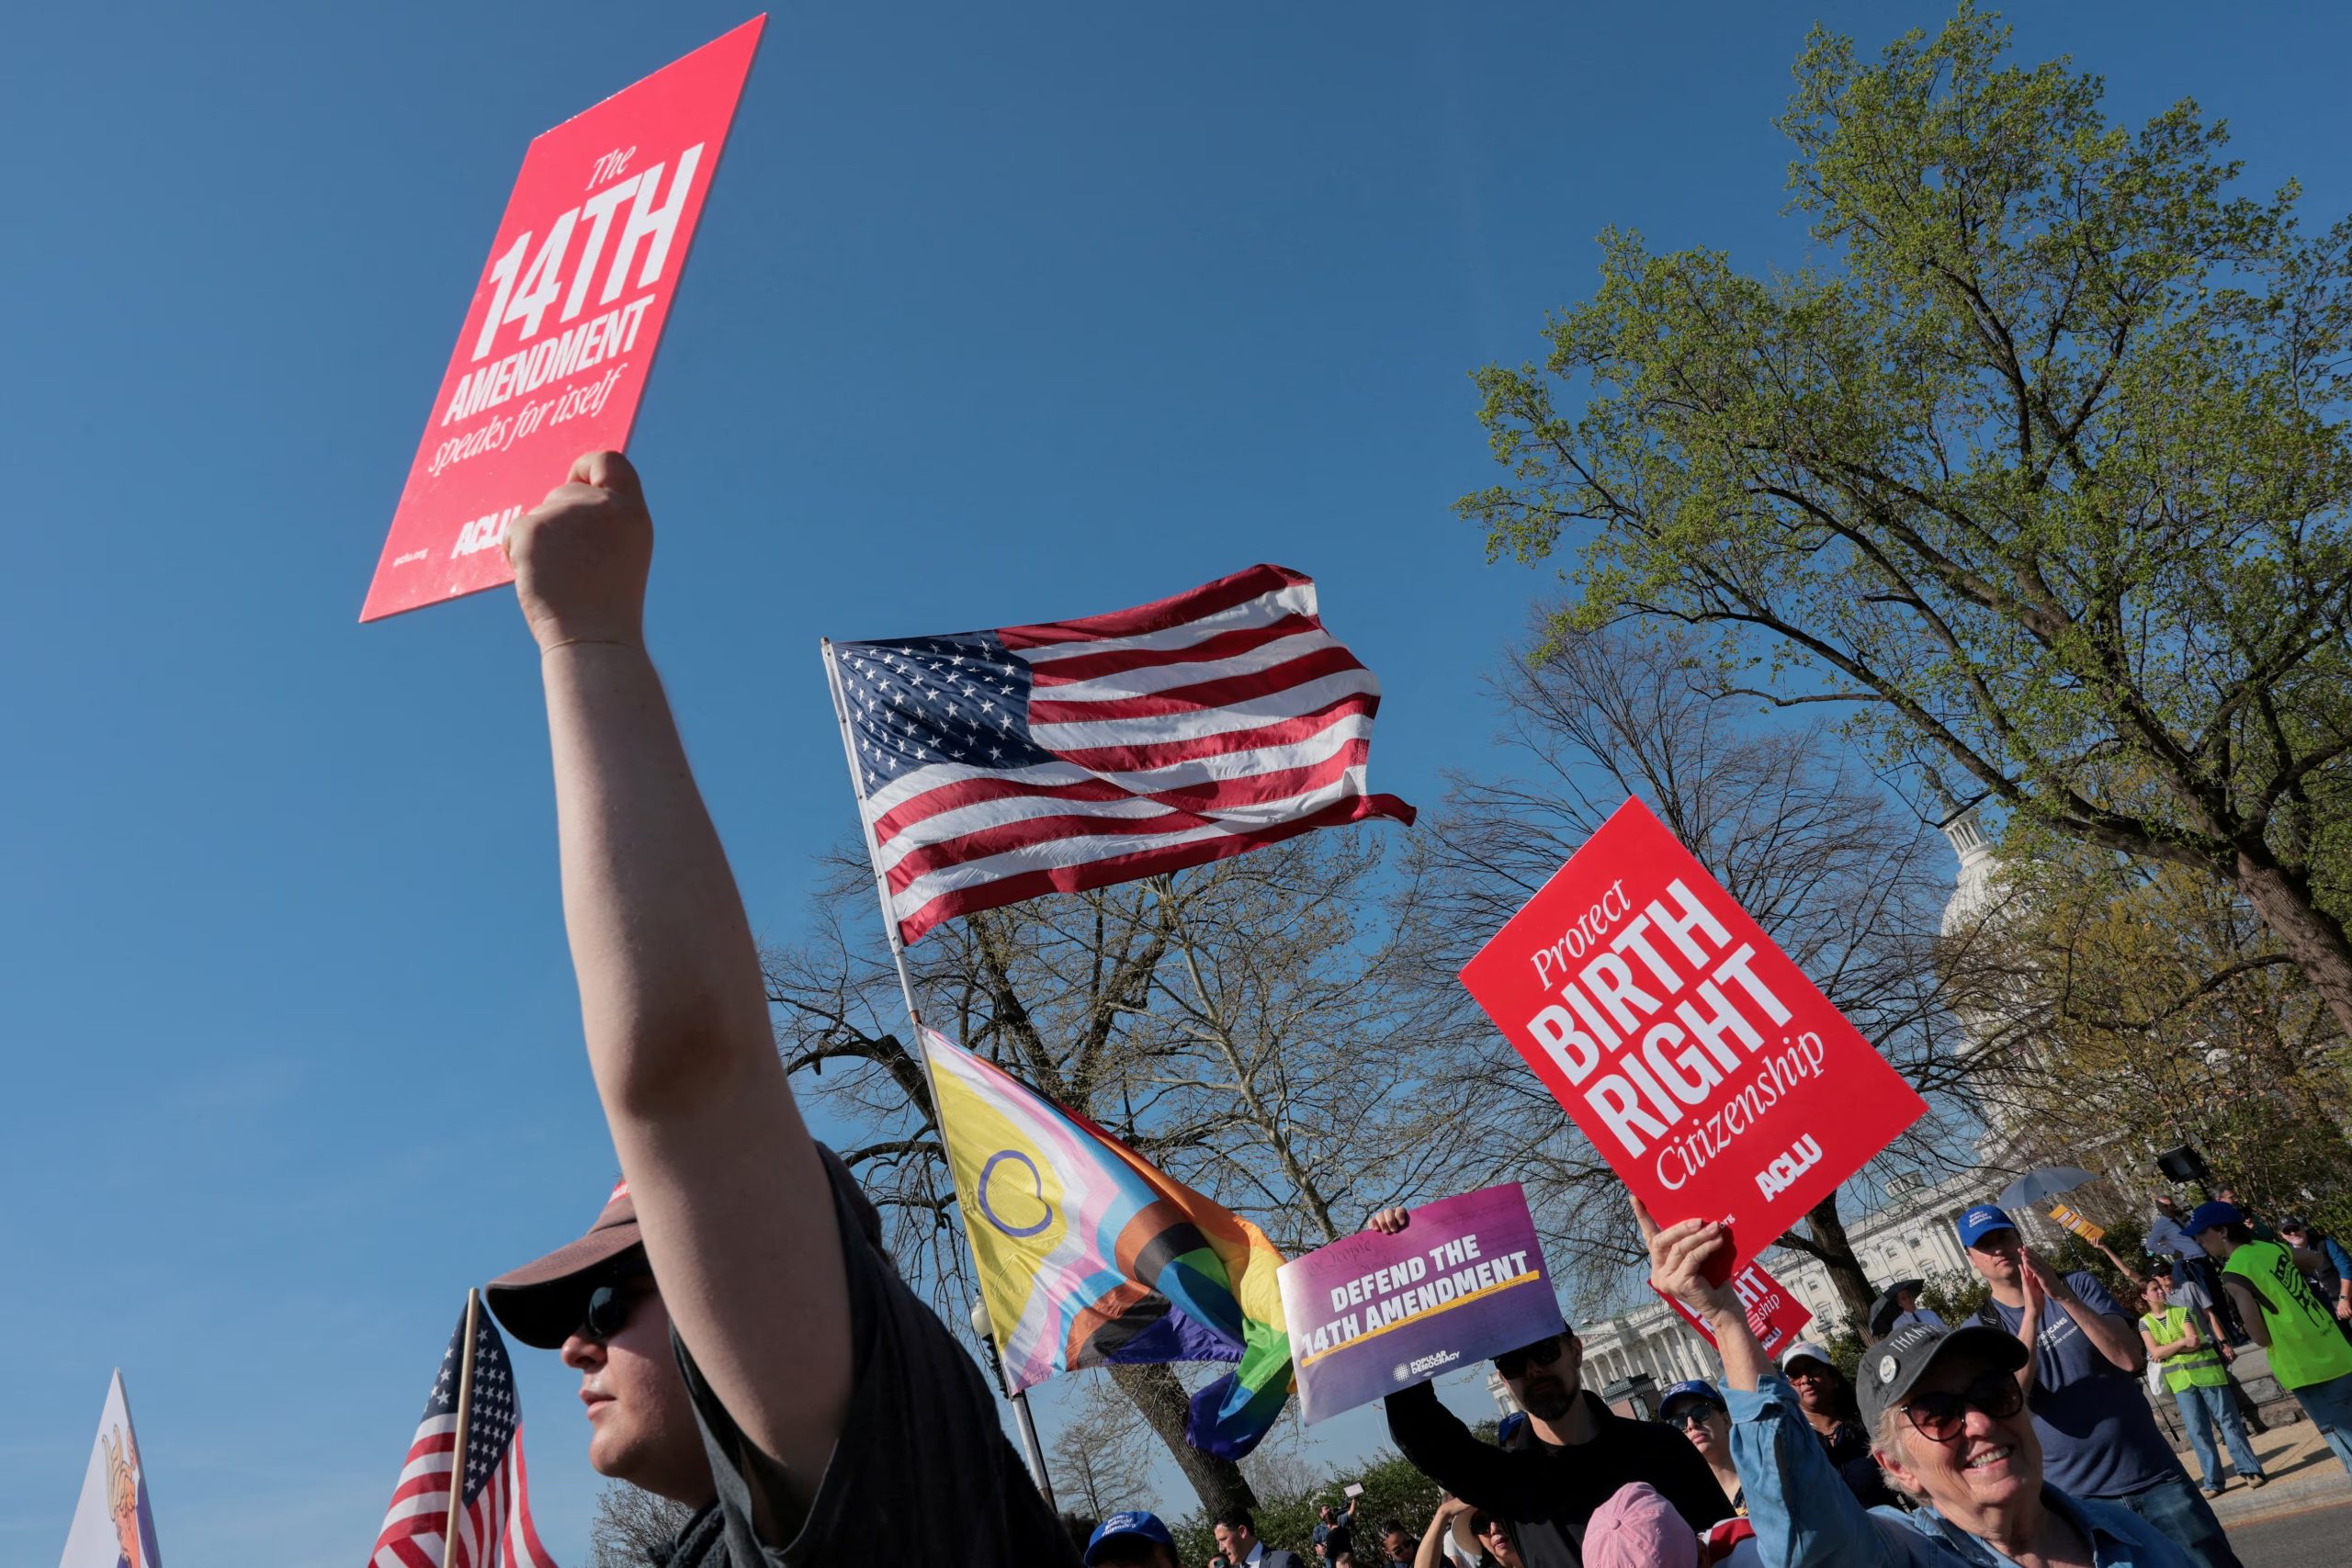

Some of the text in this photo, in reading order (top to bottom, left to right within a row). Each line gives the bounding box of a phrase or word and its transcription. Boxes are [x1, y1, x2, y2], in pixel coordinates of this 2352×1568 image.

[584, 145, 637, 191] The
[470, 141, 706, 363] 14TH
[441, 293, 656, 427] AMENDMENT
[428, 362, 629, 478] speaks for itself
[1526, 877, 1733, 1087] BIRTH
[1530, 878, 1631, 991] Protect
[1583, 942, 1793, 1159] RIGHT
[1656, 1031, 1825, 1190] Citizenship
[1754, 1133, 1823, 1202] ACLU
[1302, 1250, 1528, 1358] 14TH AMENDMENT
[1330, 1234, 1482, 1314] DEFEND THE
[1409, 1350, 1447, 1369] POPULAR
[1411, 1351, 1461, 1375] DEMOCRACY
